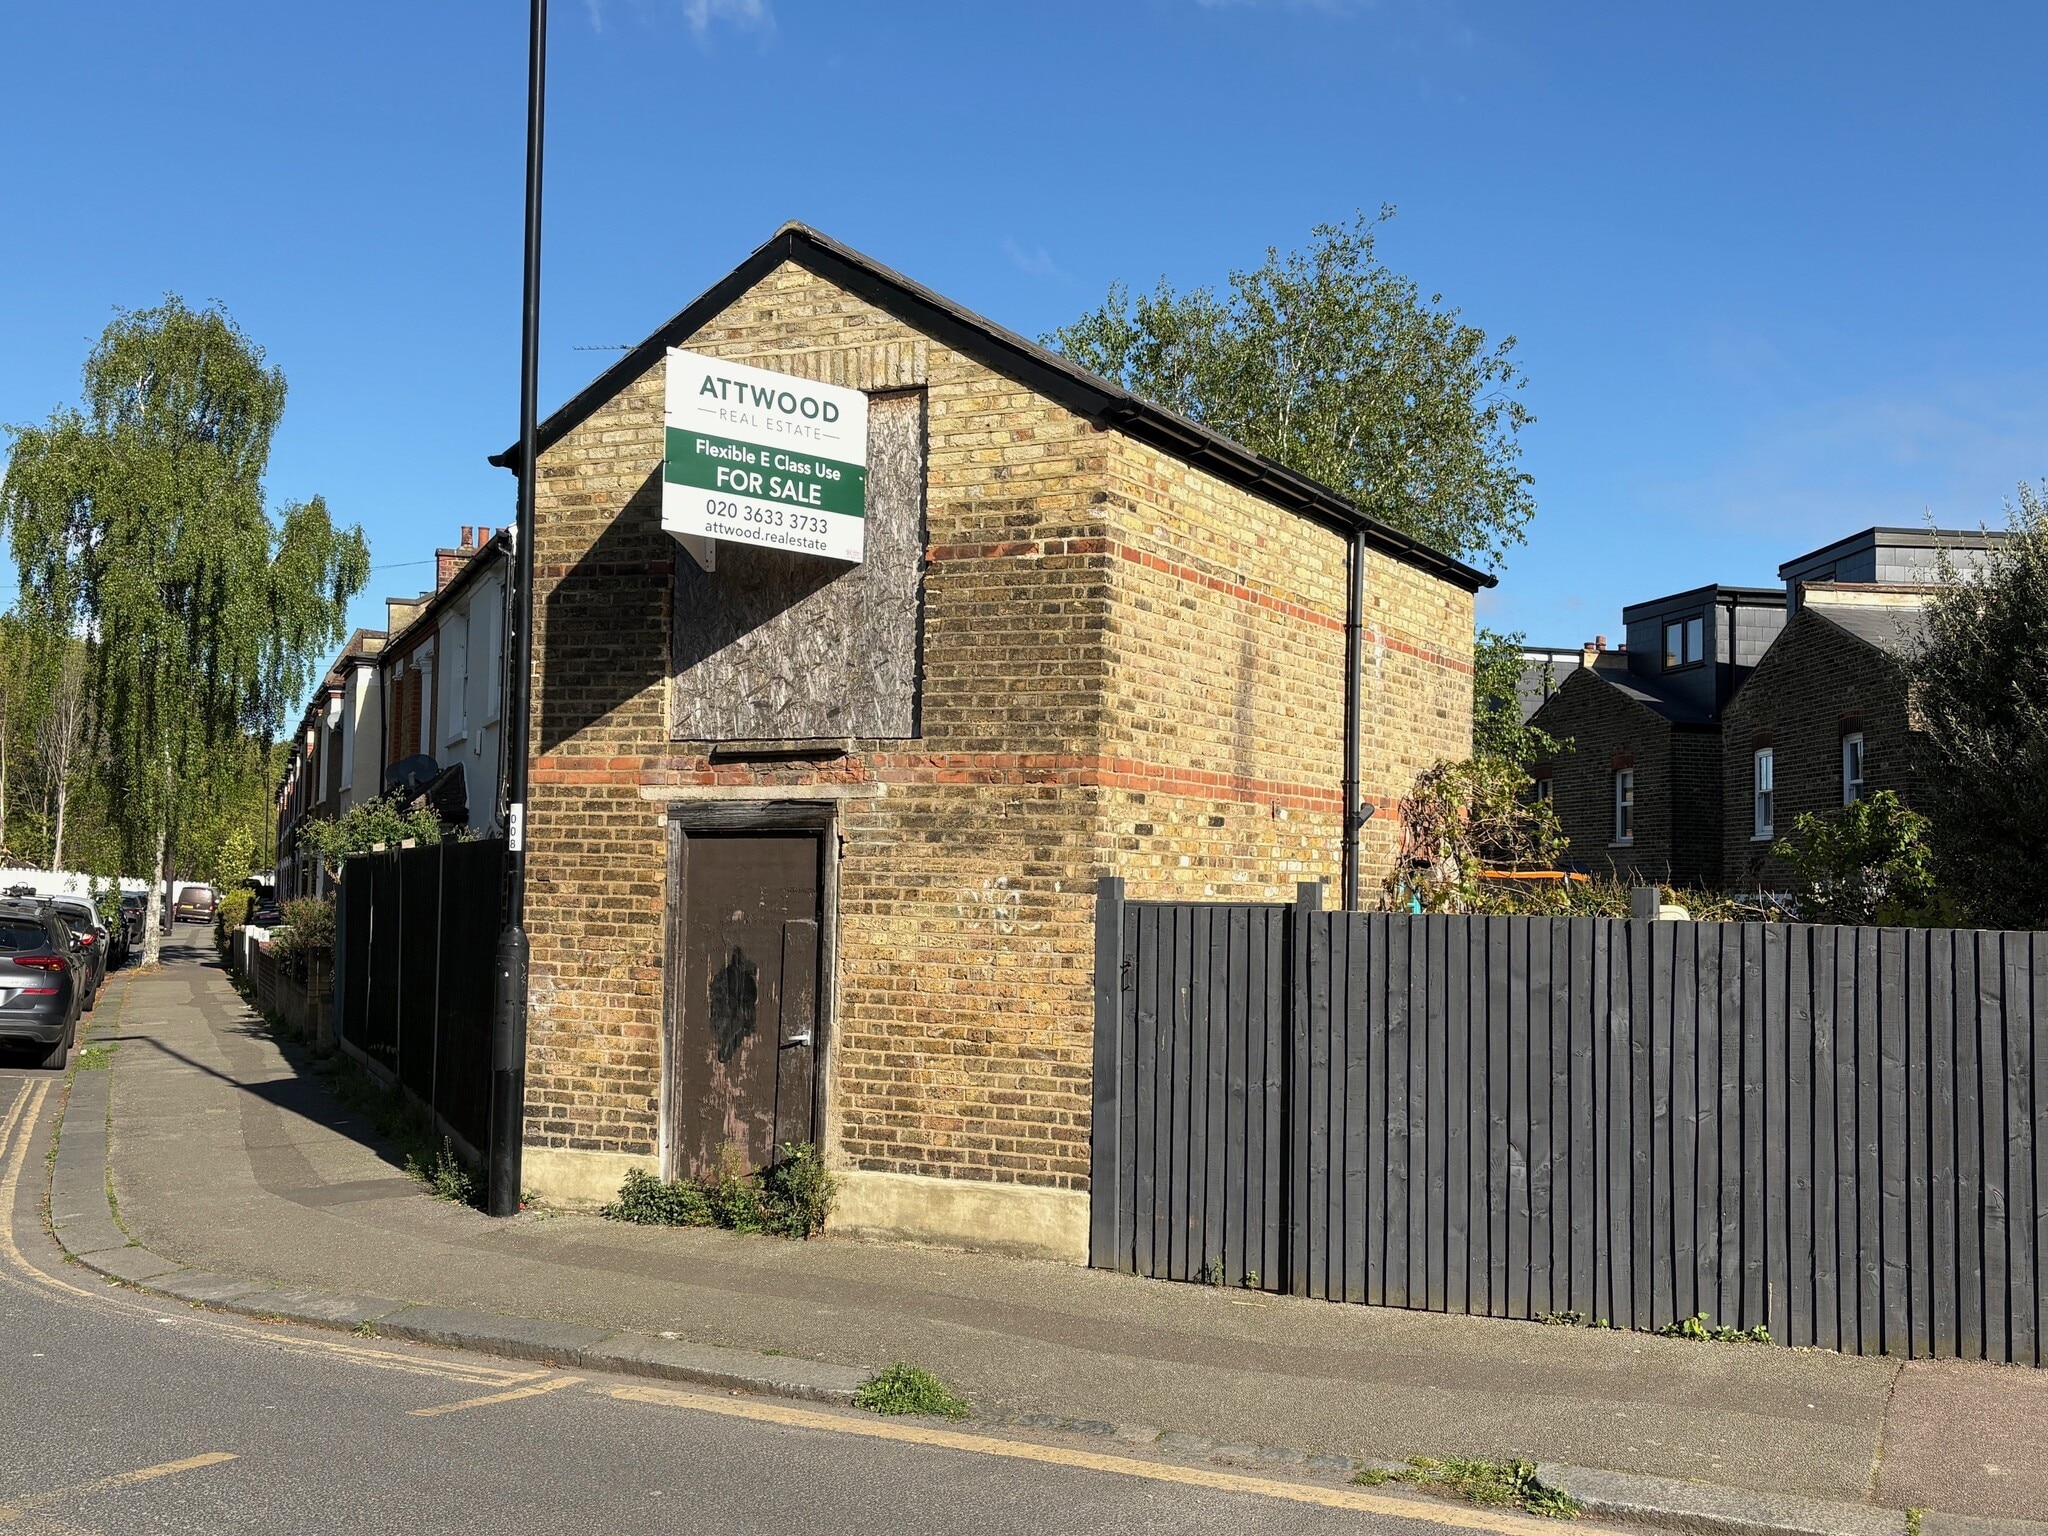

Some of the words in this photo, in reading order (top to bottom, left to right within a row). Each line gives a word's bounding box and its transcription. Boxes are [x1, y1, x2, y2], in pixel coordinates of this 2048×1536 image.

[699, 375, 839, 423] ATTWOOD
[720, 408, 758, 427] REAL
[766, 418, 821, 440] ESTATE
[696, 438, 756, 464] Flexible
[760, 451, 770, 467] E
[774, 454, 811, 475] Class
[815, 462, 841, 481] Use
[717, 466, 763, 494] FOR
[769, 476, 822, 505] SALE
[706, 499, 738, 518] 020
[743, 505, 783, 527] 3633
[789, 513, 828, 534] 3733
[705, 521, 827, 551] attwood.realestate
